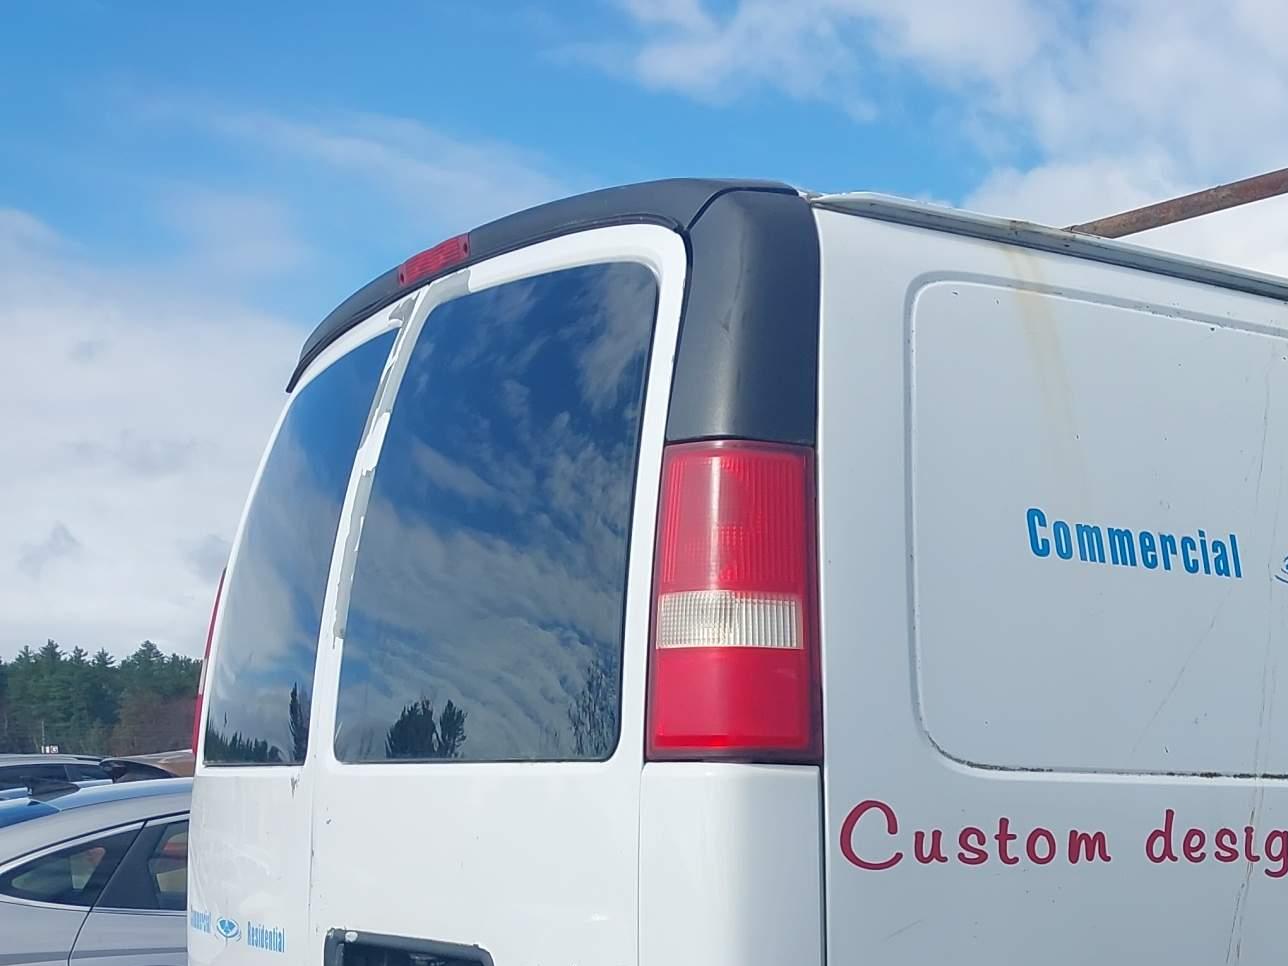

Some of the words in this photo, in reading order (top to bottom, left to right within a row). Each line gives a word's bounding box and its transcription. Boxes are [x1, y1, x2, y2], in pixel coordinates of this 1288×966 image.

[1026, 507, 1243, 578] Commercial
[840, 800, 1111, 870] Custom
[247, 920, 285, 953] Residential
